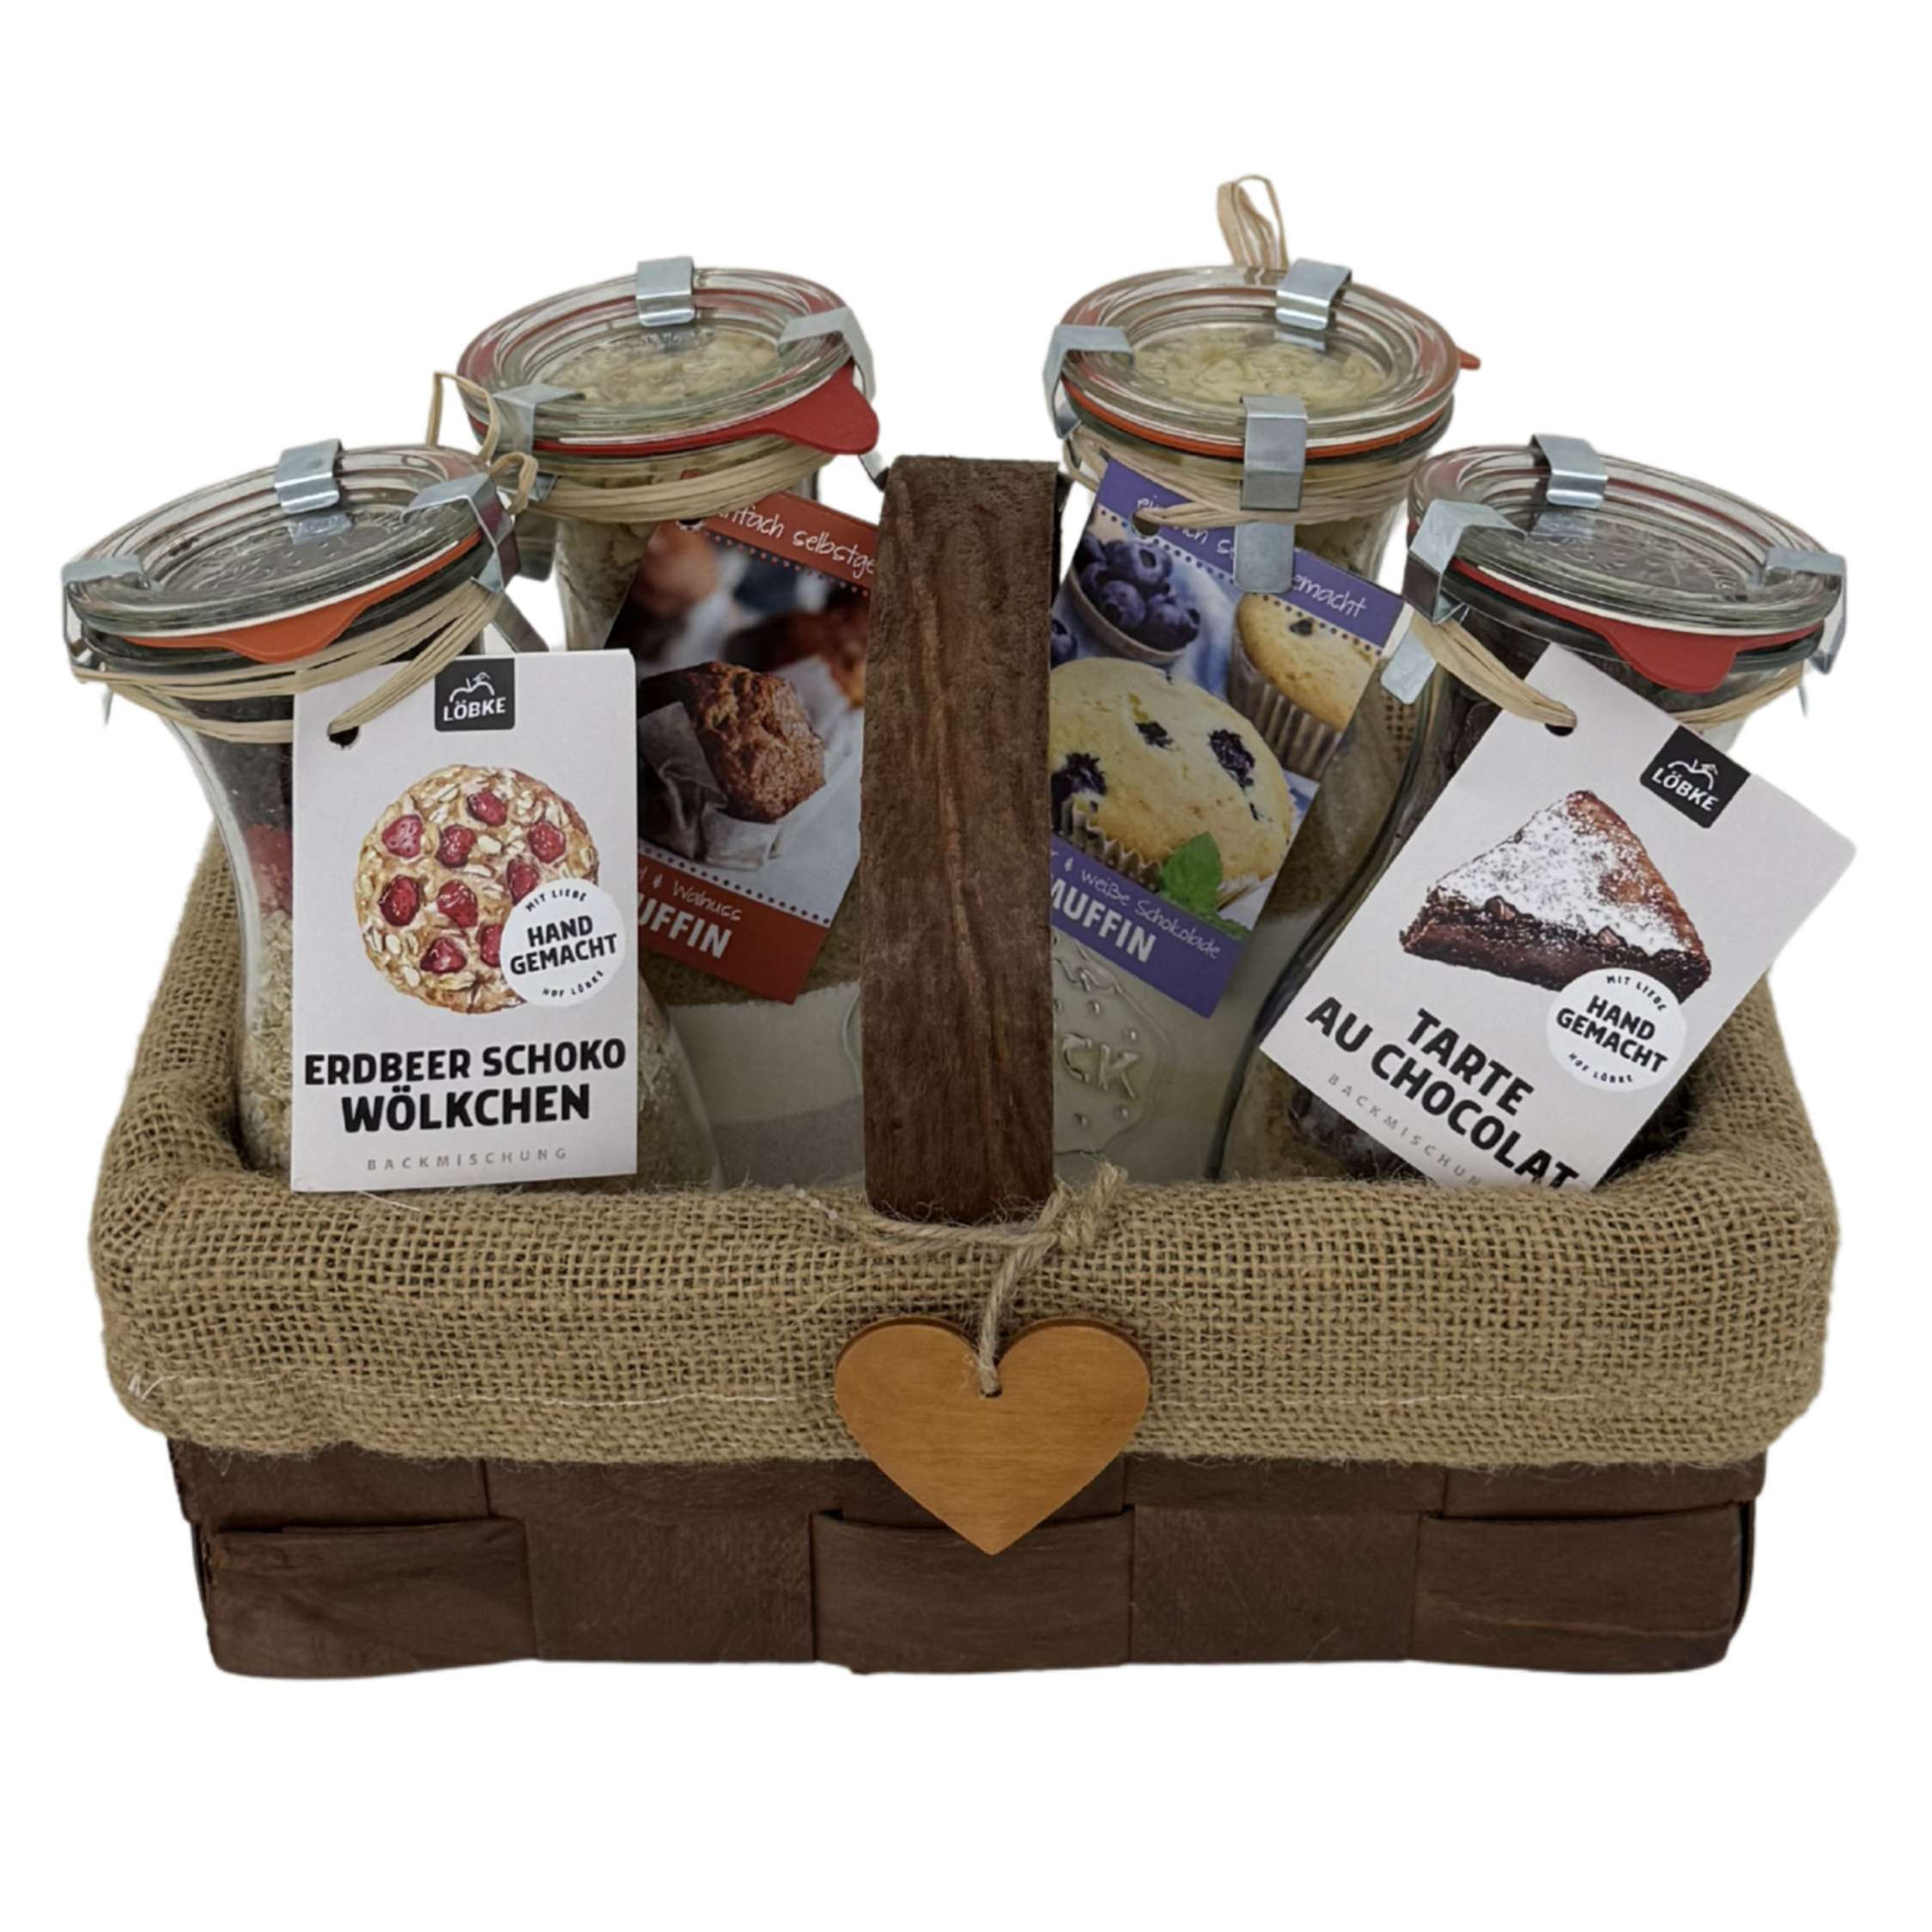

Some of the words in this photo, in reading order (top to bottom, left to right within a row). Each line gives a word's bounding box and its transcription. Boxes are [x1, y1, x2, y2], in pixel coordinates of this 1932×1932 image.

[793, 531, 876, 580] selbstge
[443, 696, 506, 721] LÖBKE
[1651, 768, 1719, 811] LÖBKE
[526, 893, 546, 912] MIT
[638, 893, 732, 959] UFFIN
[527, 915, 593, 947] HAND
[1134, 900, 1221, 959] Schokolade
[510, 933, 617, 975] GEMACHT
[1607, 975, 1631, 985] MIT
[1556, 1007, 1668, 1072] GEMACHT
[1586, 994, 1656, 1041] HAND
[305, 1048, 471, 1085] ERDBEER
[483, 1038, 626, 1077] SCHOKO
[1406, 1007, 1534, 1116] TARTE
[342, 1083, 590, 1133] WÖLKCHEN
[1305, 996, 1373, 1053] AU
[1370, 1043, 1579, 1190] CHOCOLAT
[1328, 1073, 1482, 1187] BACKMISCHUN
[368, 1147, 567, 1171] BACKMISCHUNG
